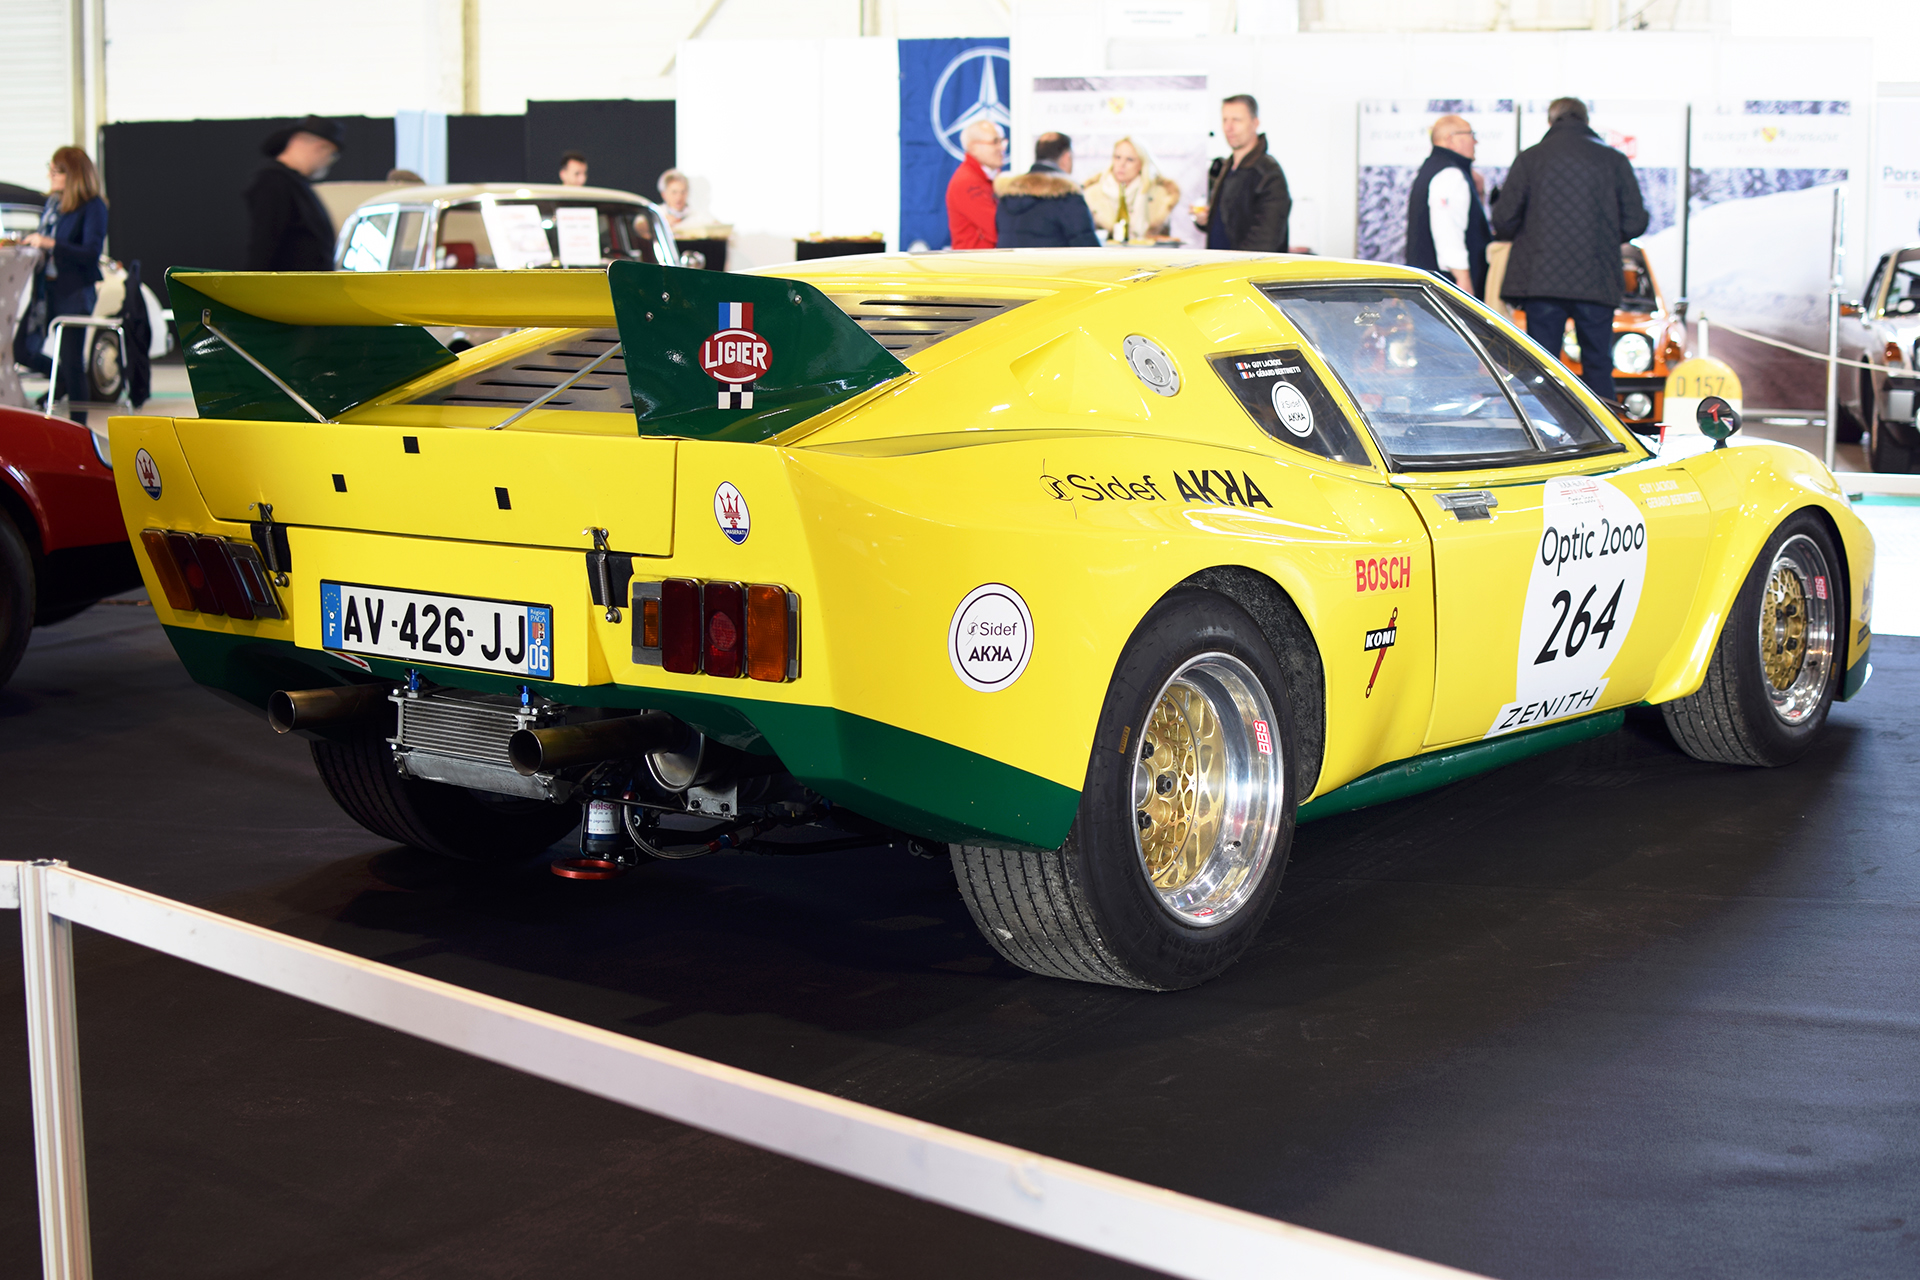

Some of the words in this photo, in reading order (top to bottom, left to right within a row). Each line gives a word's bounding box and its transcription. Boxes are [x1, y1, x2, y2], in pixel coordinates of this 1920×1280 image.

[705, 341, 768, 370] LIGIER
[1251, 360, 1262, 369] GUY
[1262, 359, 1283, 367] LACROIX
[1275, 366, 1301, 375] BERTINETTI
[1677, 376, 1686, 397] D
[1696, 376, 1725, 397] 157
[1288, 412, 1307, 422] AKKA
[1066, 474, 1167, 501] Sidef
[1173, 470, 1274, 508] AKKA
[1638, 483, 1654, 494] GUY
[1654, 480, 1679, 493] LACROIX
[1671, 491, 1703, 506] BERTINETTI
[1541, 521, 1596, 577] Optic
[1599, 518, 1645, 556] 2000
[1355, 556, 1411, 592] BOSCH
[1815, 577, 1827, 599] BBS
[530, 614, 546, 623] PACA
[979, 621, 1018, 636] Sidef
[1533, 578, 1626, 666] 264
[329, 623, 336, 637] F
[344, 595, 526, 664] AV-426-JJ
[1365, 629, 1396, 648] KONI
[529, 644, 549, 671] 06
[968, 645, 1013, 662] AKKA
[1498, 686, 1600, 730] ZENITH
[1254, 721, 1271, 754] BBS
